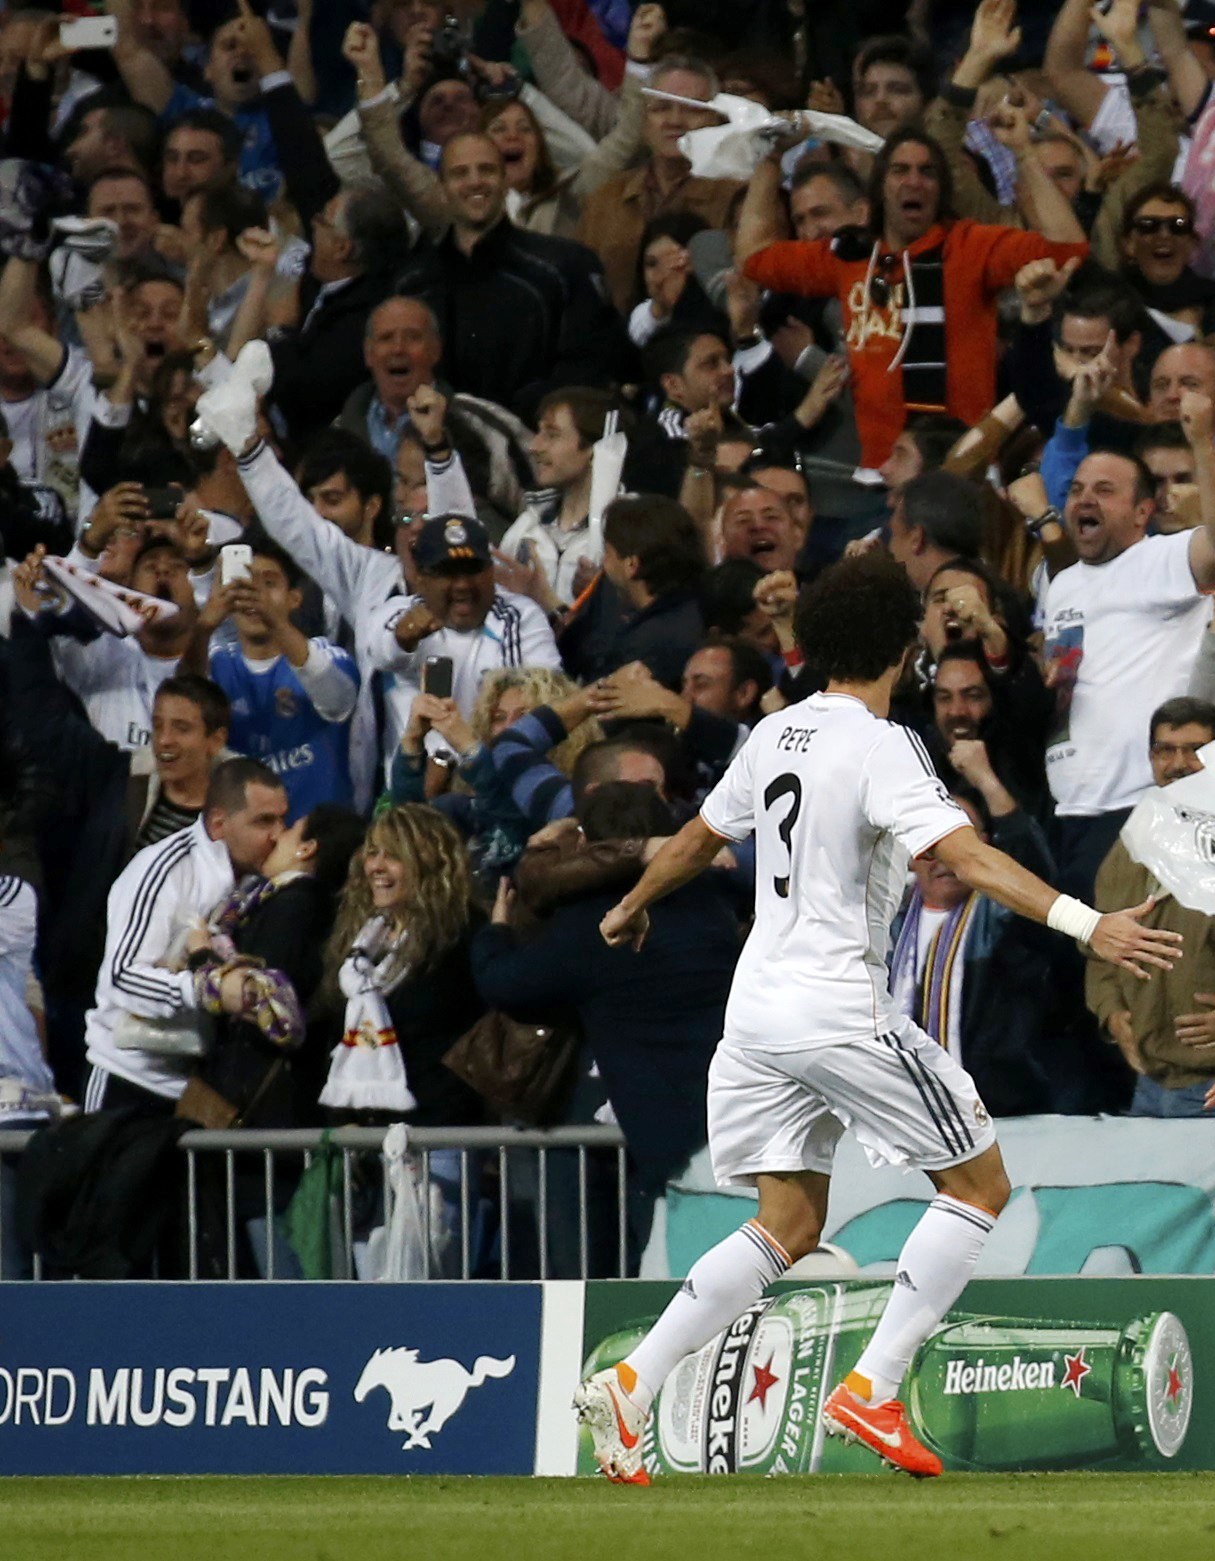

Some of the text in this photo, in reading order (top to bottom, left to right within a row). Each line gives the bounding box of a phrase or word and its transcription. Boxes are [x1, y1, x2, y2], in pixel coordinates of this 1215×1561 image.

[777, 726, 818, 753] PEPE
[764, 772, 802, 899] 3
[87, 1367, 329, 1427] MUSTANG
[943, 1356, 1056, 1394] Heineken
